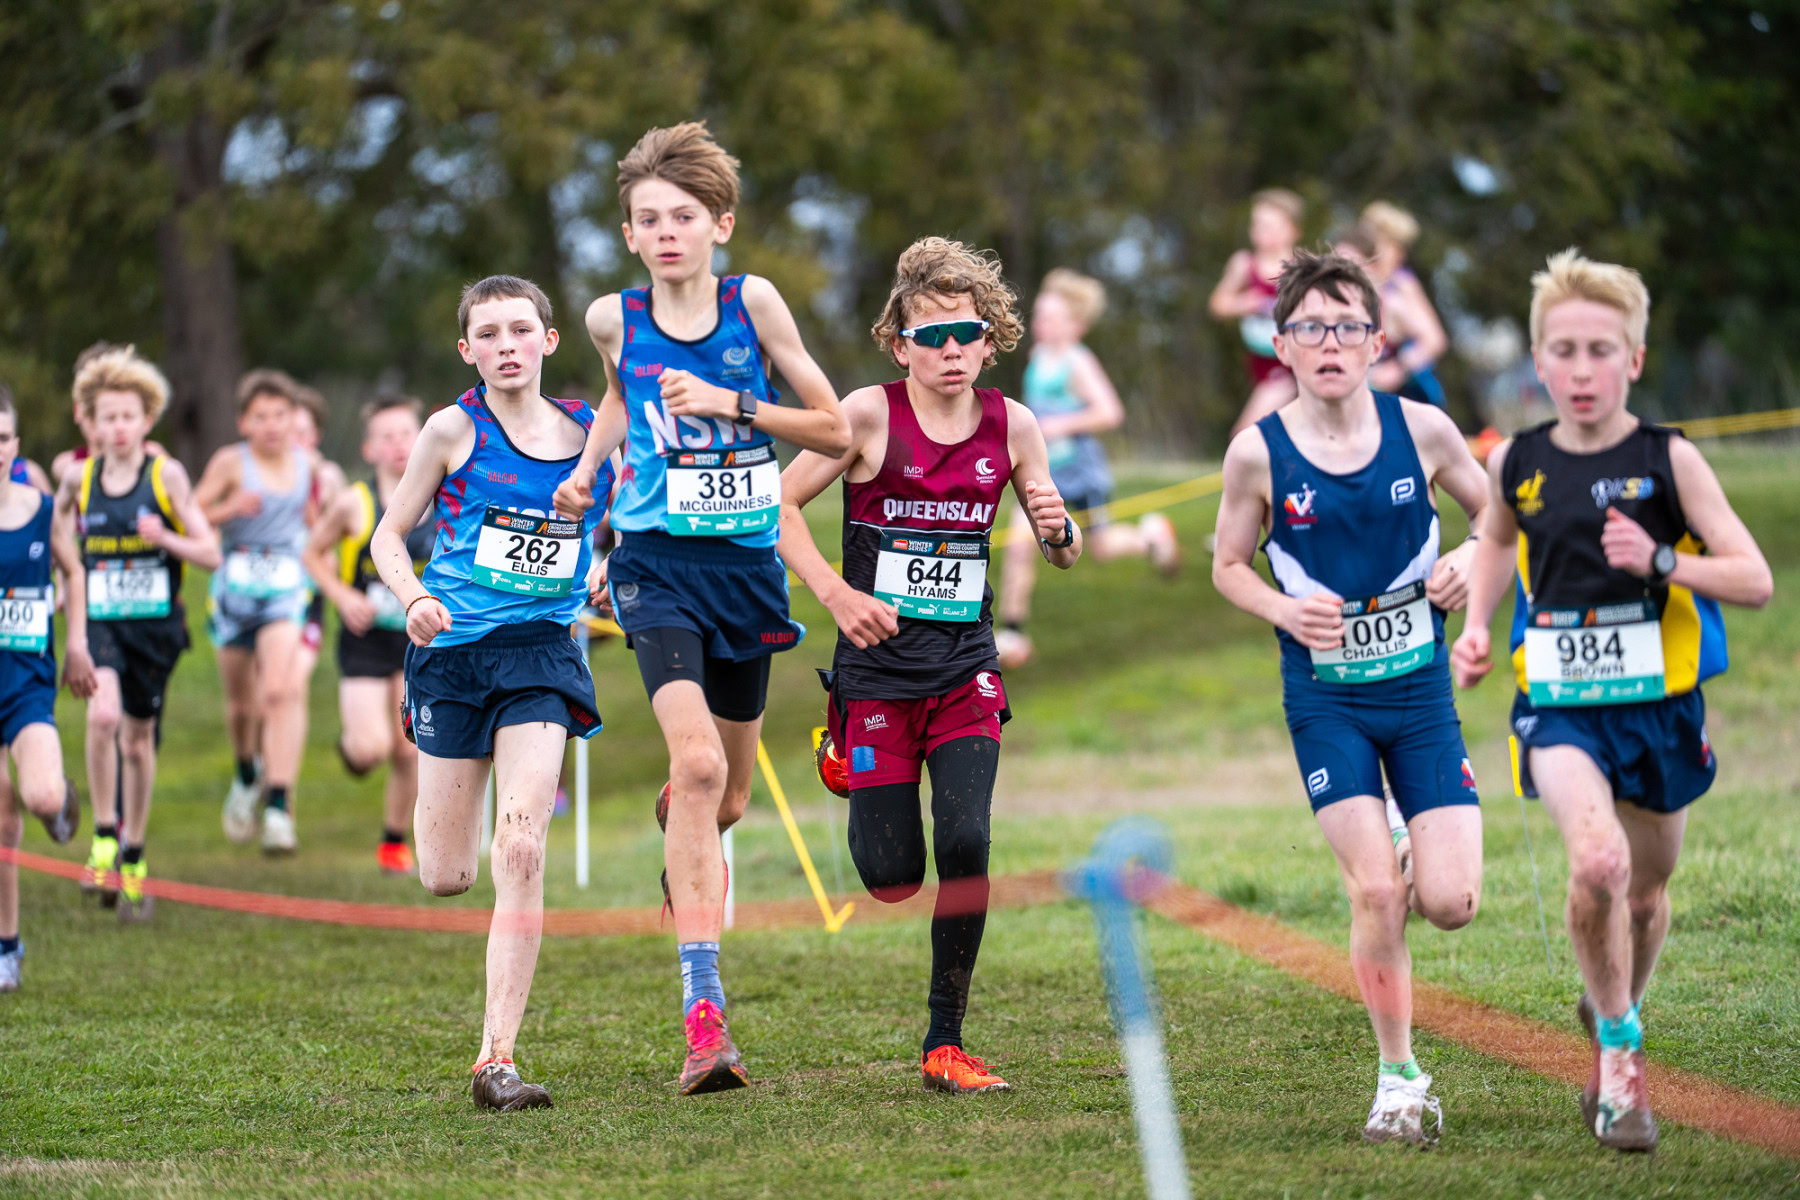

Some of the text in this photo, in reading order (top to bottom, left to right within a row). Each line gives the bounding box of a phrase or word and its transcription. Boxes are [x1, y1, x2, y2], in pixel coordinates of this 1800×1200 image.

[488, 471, 517, 484] VALOUR
[698, 469, 752, 499] 381
[680, 494, 772, 511] MCGUINNESS
[511, 517, 535, 527] WINTER
[505, 535, 561, 566] 262
[909, 540, 932, 548] WINTER
[511, 561, 548, 576] ELLIS
[907, 558, 962, 588] 644
[907, 585, 957, 599] HYAMS
[761, 632, 795, 643] VALOUR
[1342, 639, 1407, 660] CHALLIS
[1557, 629, 1624, 663] 984
[864, 713, 886, 726] IMPI
